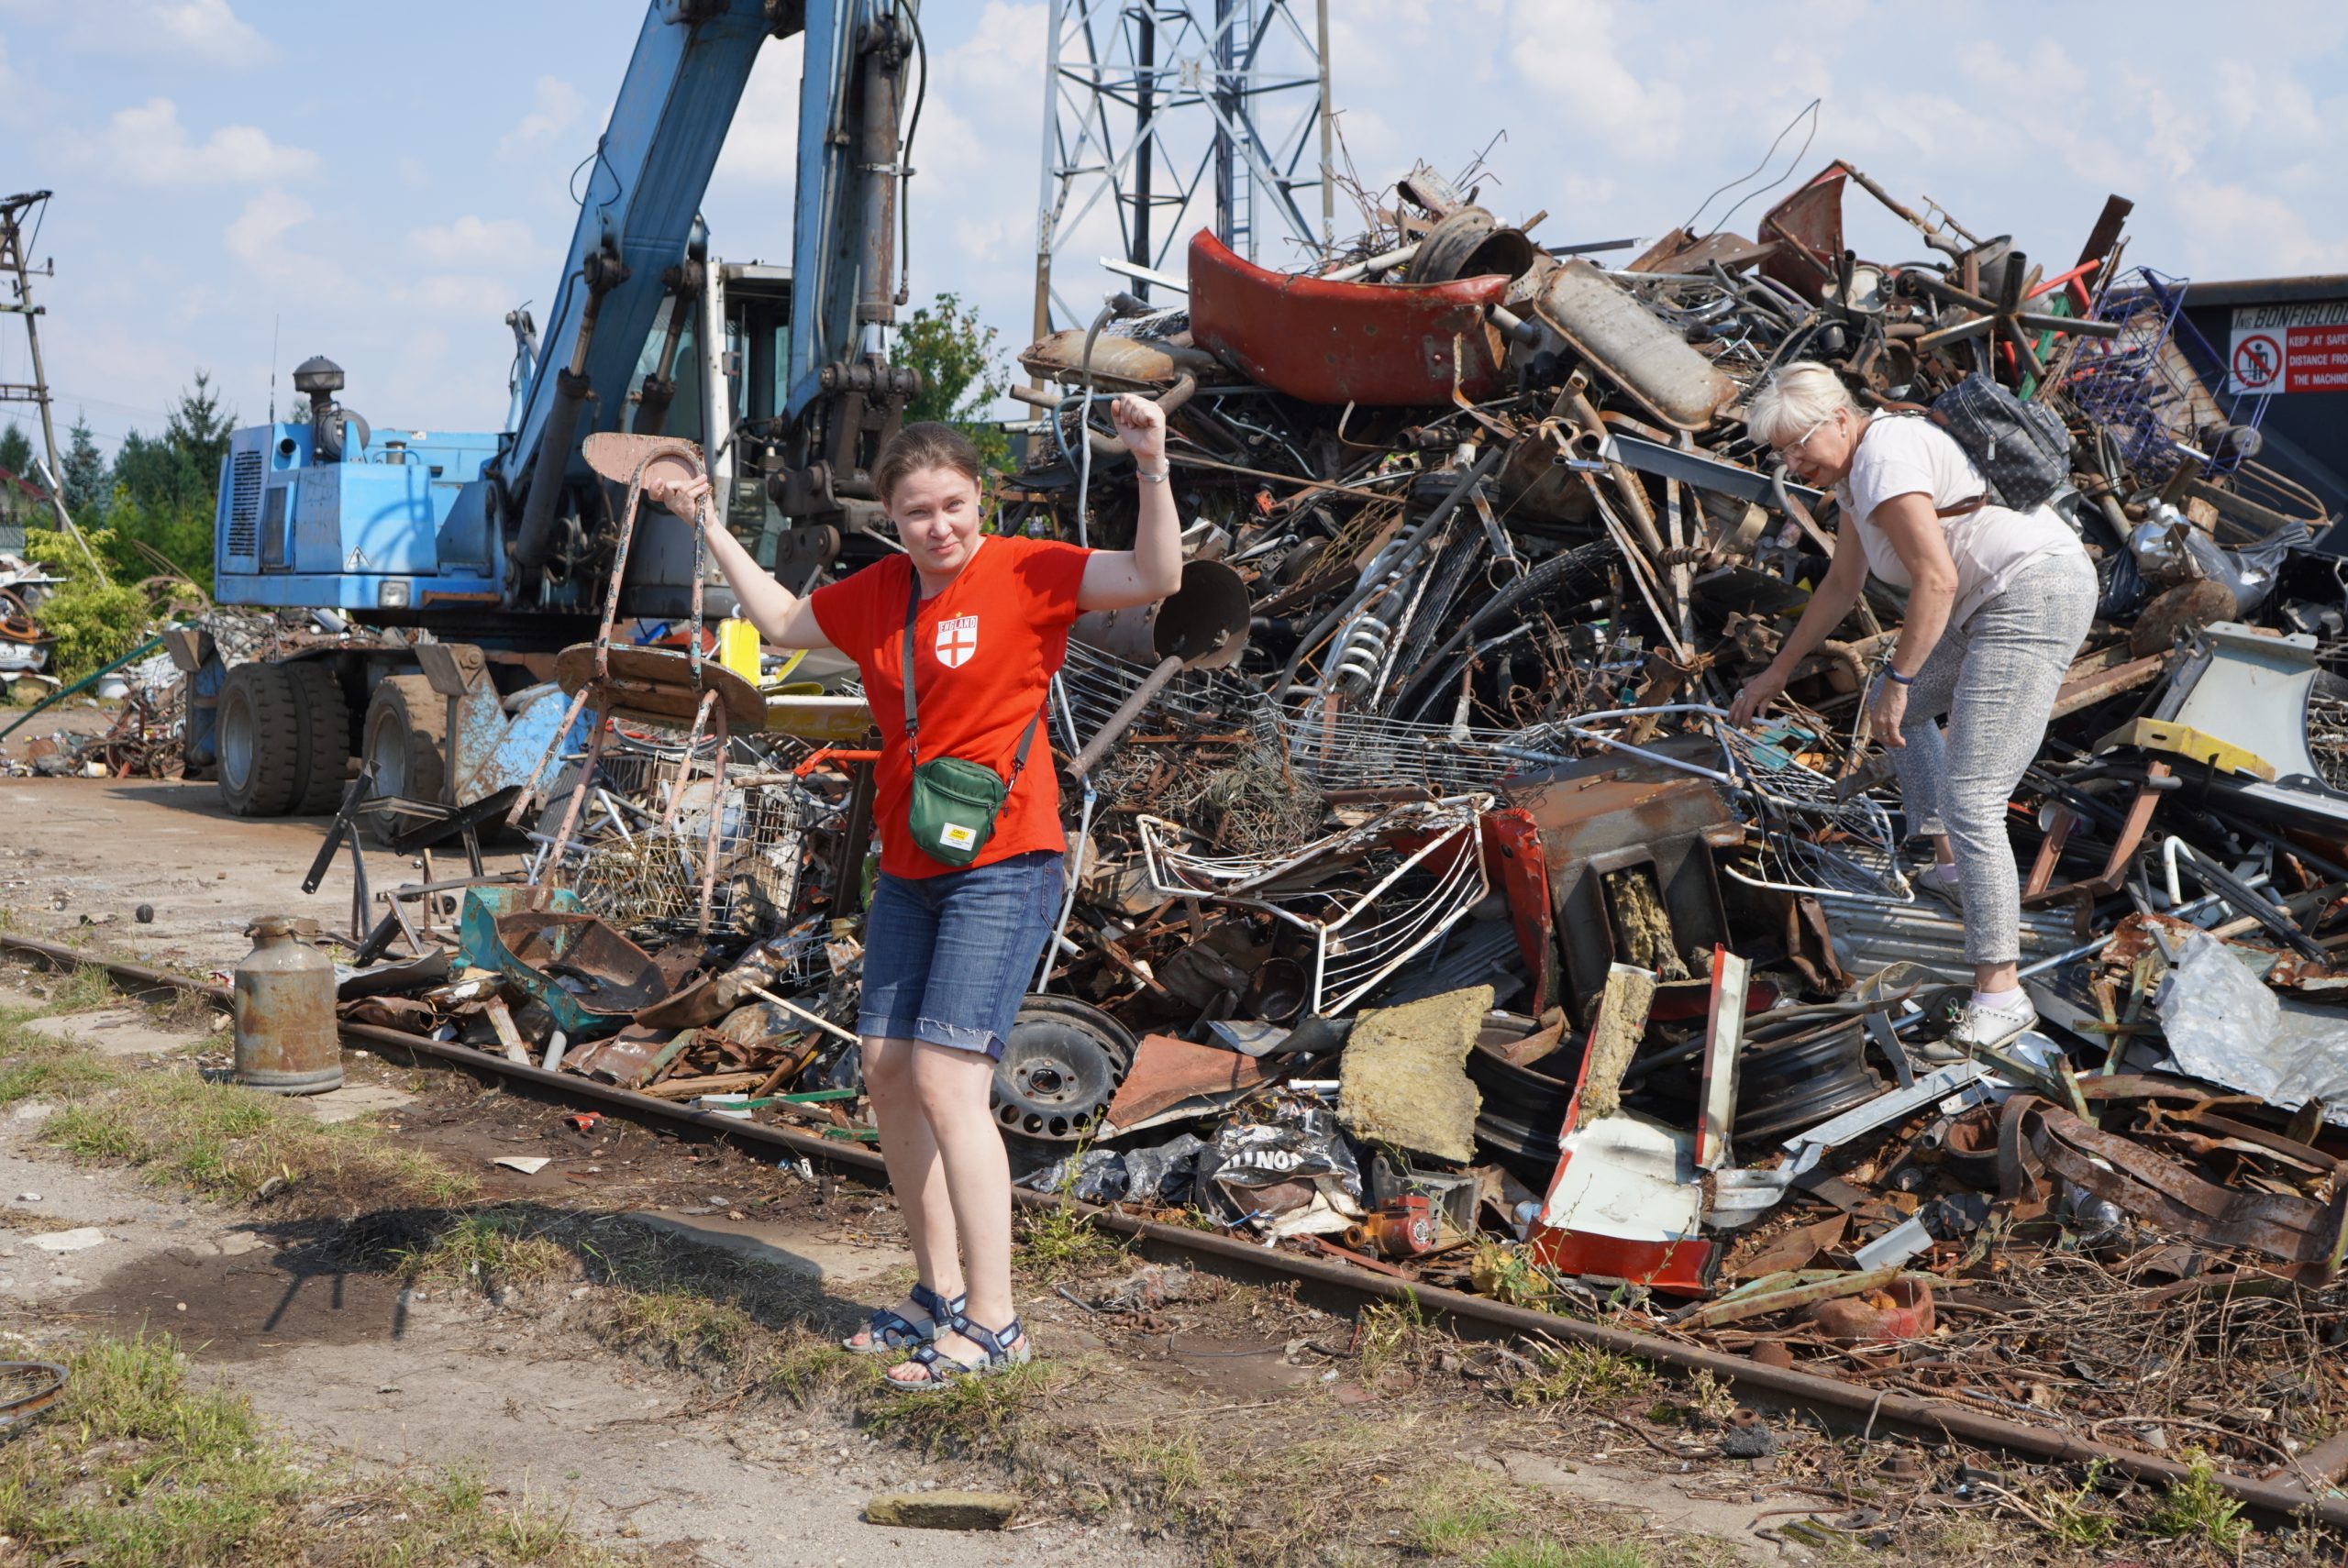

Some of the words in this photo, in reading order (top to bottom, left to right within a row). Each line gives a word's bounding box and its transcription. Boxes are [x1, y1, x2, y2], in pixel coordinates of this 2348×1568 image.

[2288, 336, 2309, 347] KEEP
[2313, 335, 2323, 346] AT
[2288, 353, 2328, 367] DISTANCE
[2294, 374, 2309, 385] THE
[940, 617, 975, 632] ENGLAND
